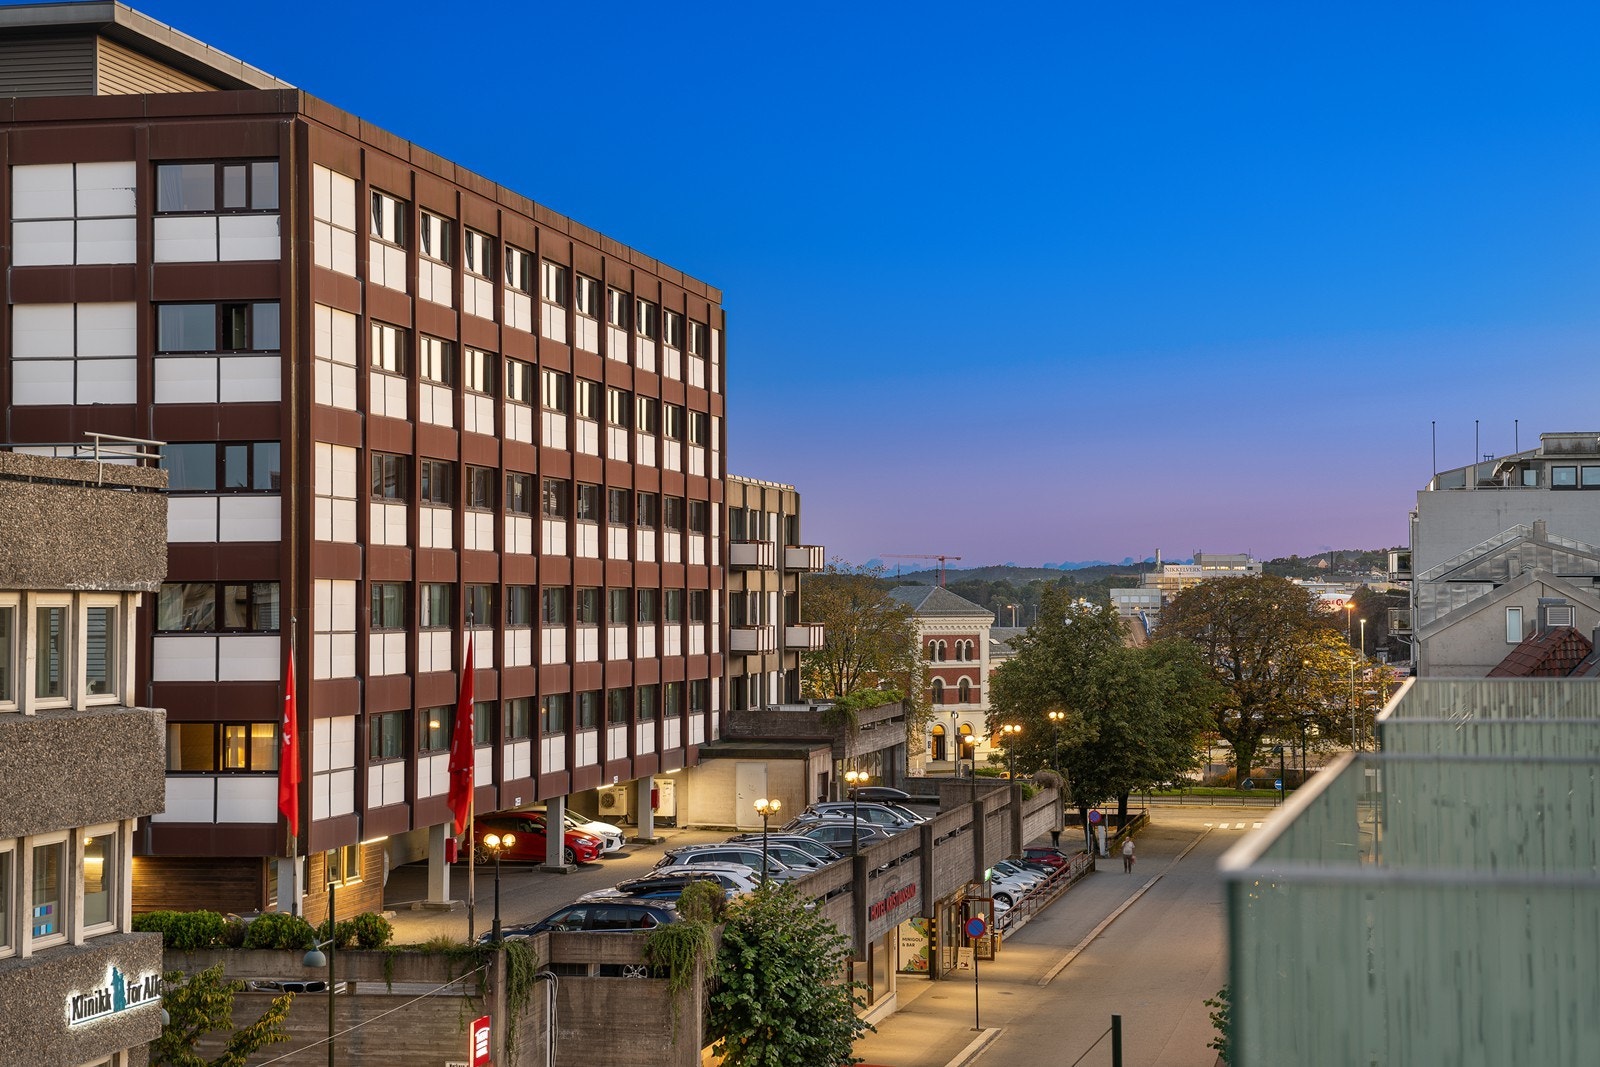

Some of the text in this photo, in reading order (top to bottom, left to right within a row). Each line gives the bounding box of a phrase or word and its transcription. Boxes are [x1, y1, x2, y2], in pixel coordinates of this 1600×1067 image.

[72, 975, 163, 1021] Klinikk for Alle
